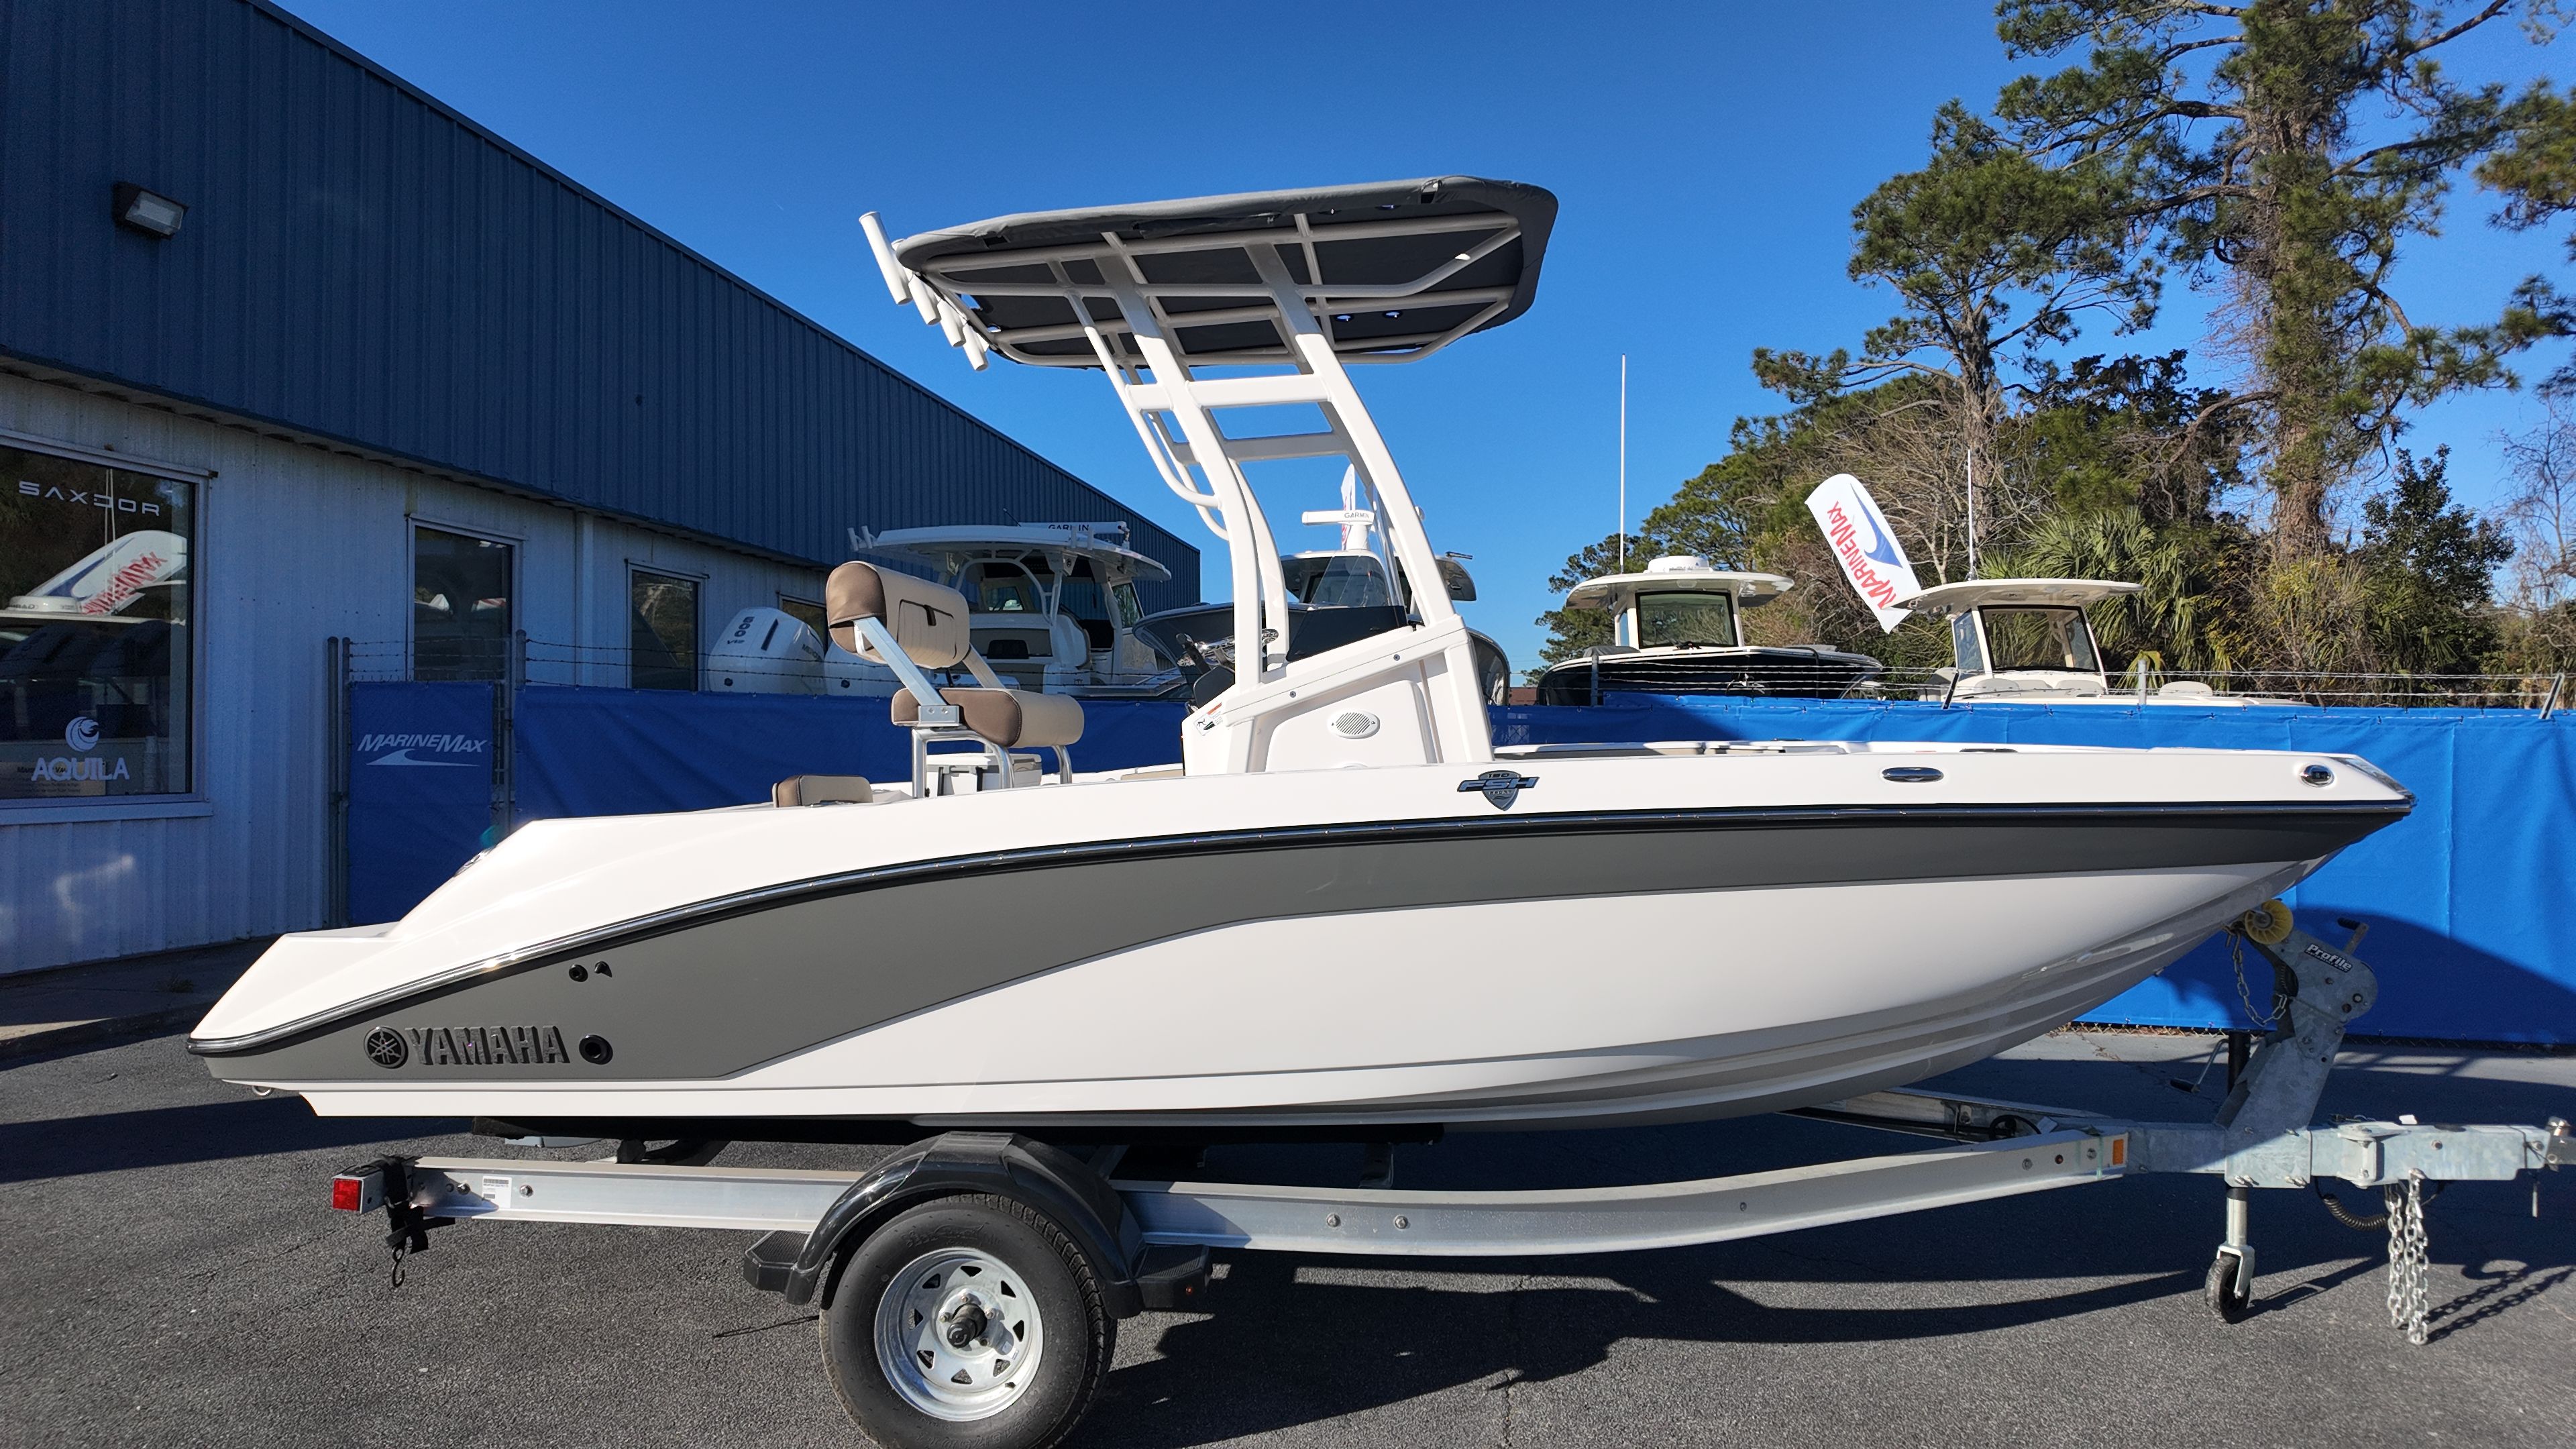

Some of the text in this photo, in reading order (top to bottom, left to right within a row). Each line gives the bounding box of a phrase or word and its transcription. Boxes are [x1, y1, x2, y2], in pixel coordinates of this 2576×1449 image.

[1827, 500, 1896, 610] MARINEMAX
[734, 616, 755, 637] 500
[357, 734, 488, 753] MARINEMAX
[32, 757, 129, 781] AQUILA
[1458, 777, 1538, 792] FSH
[2308, 944, 2352, 971] Profile
[405, 1026, 570, 1065] YAMAHA
